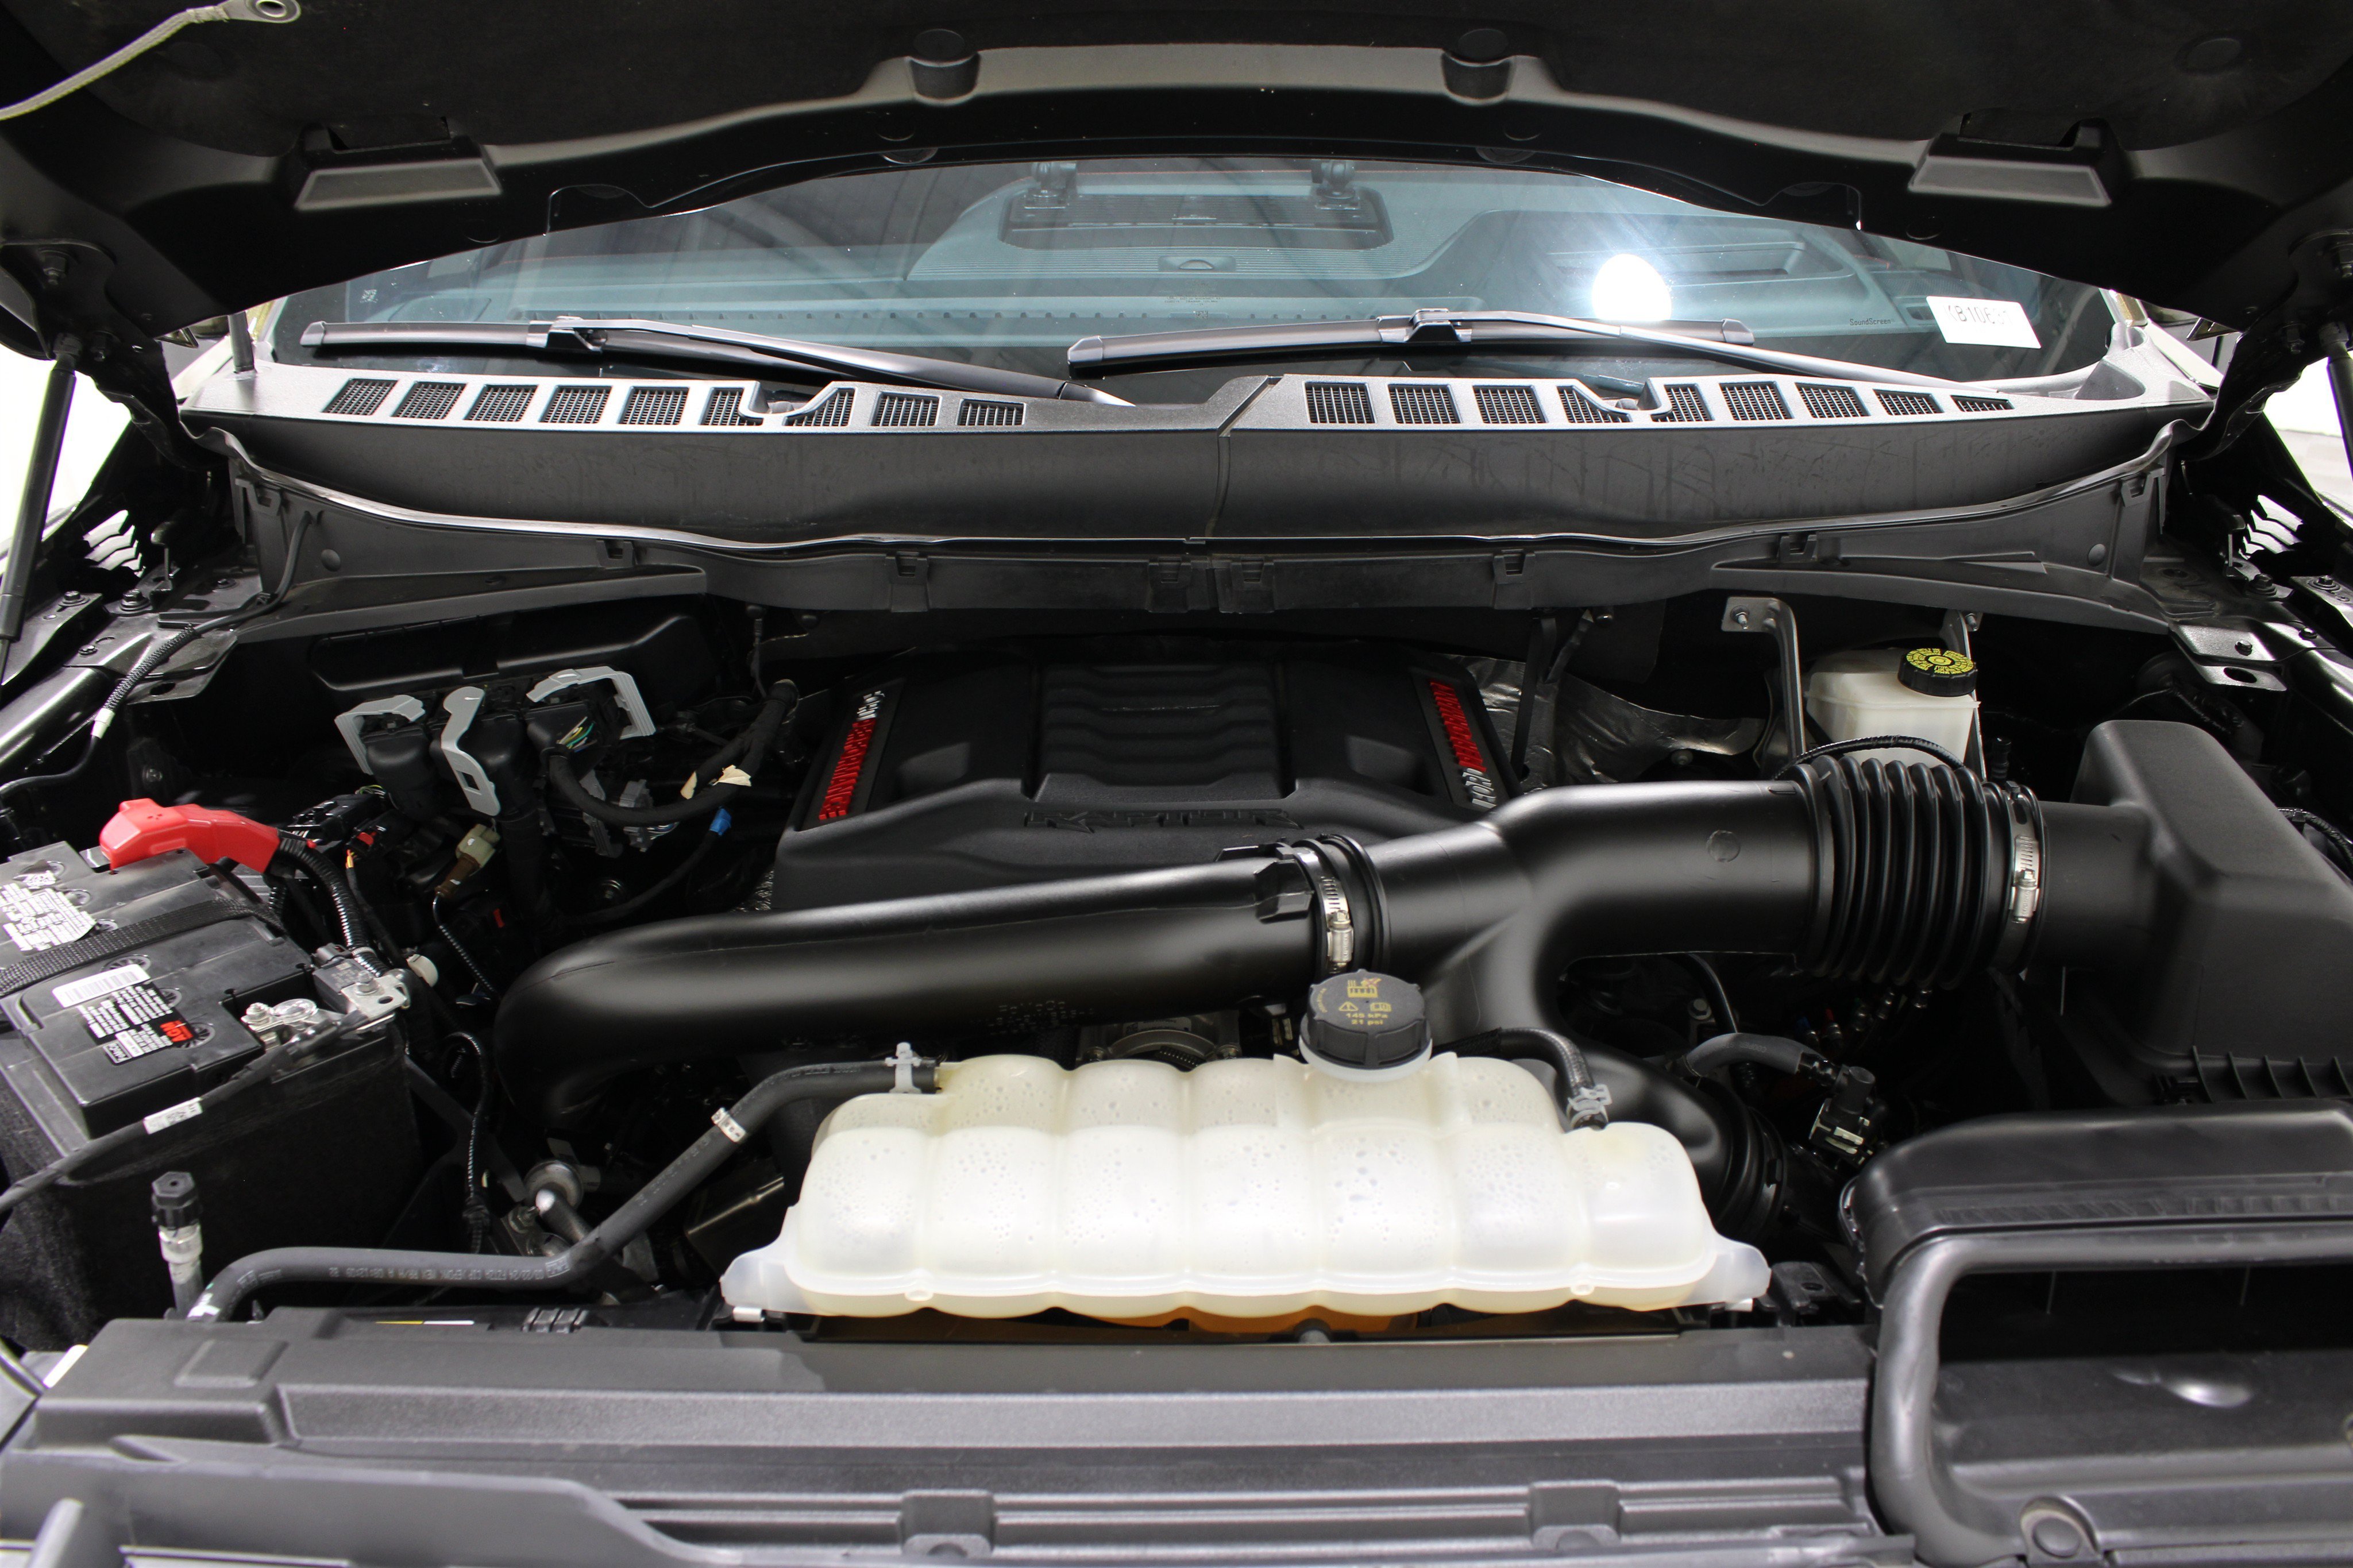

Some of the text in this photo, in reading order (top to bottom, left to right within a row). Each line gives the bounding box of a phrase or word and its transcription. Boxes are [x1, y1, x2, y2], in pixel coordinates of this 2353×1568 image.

[1849, 318, 1892, 326] SoundScreen
[819, 690, 885, 820] FORD PERFORMANCE
[1430, 682, 1497, 809] FORD PERFORMANCE
